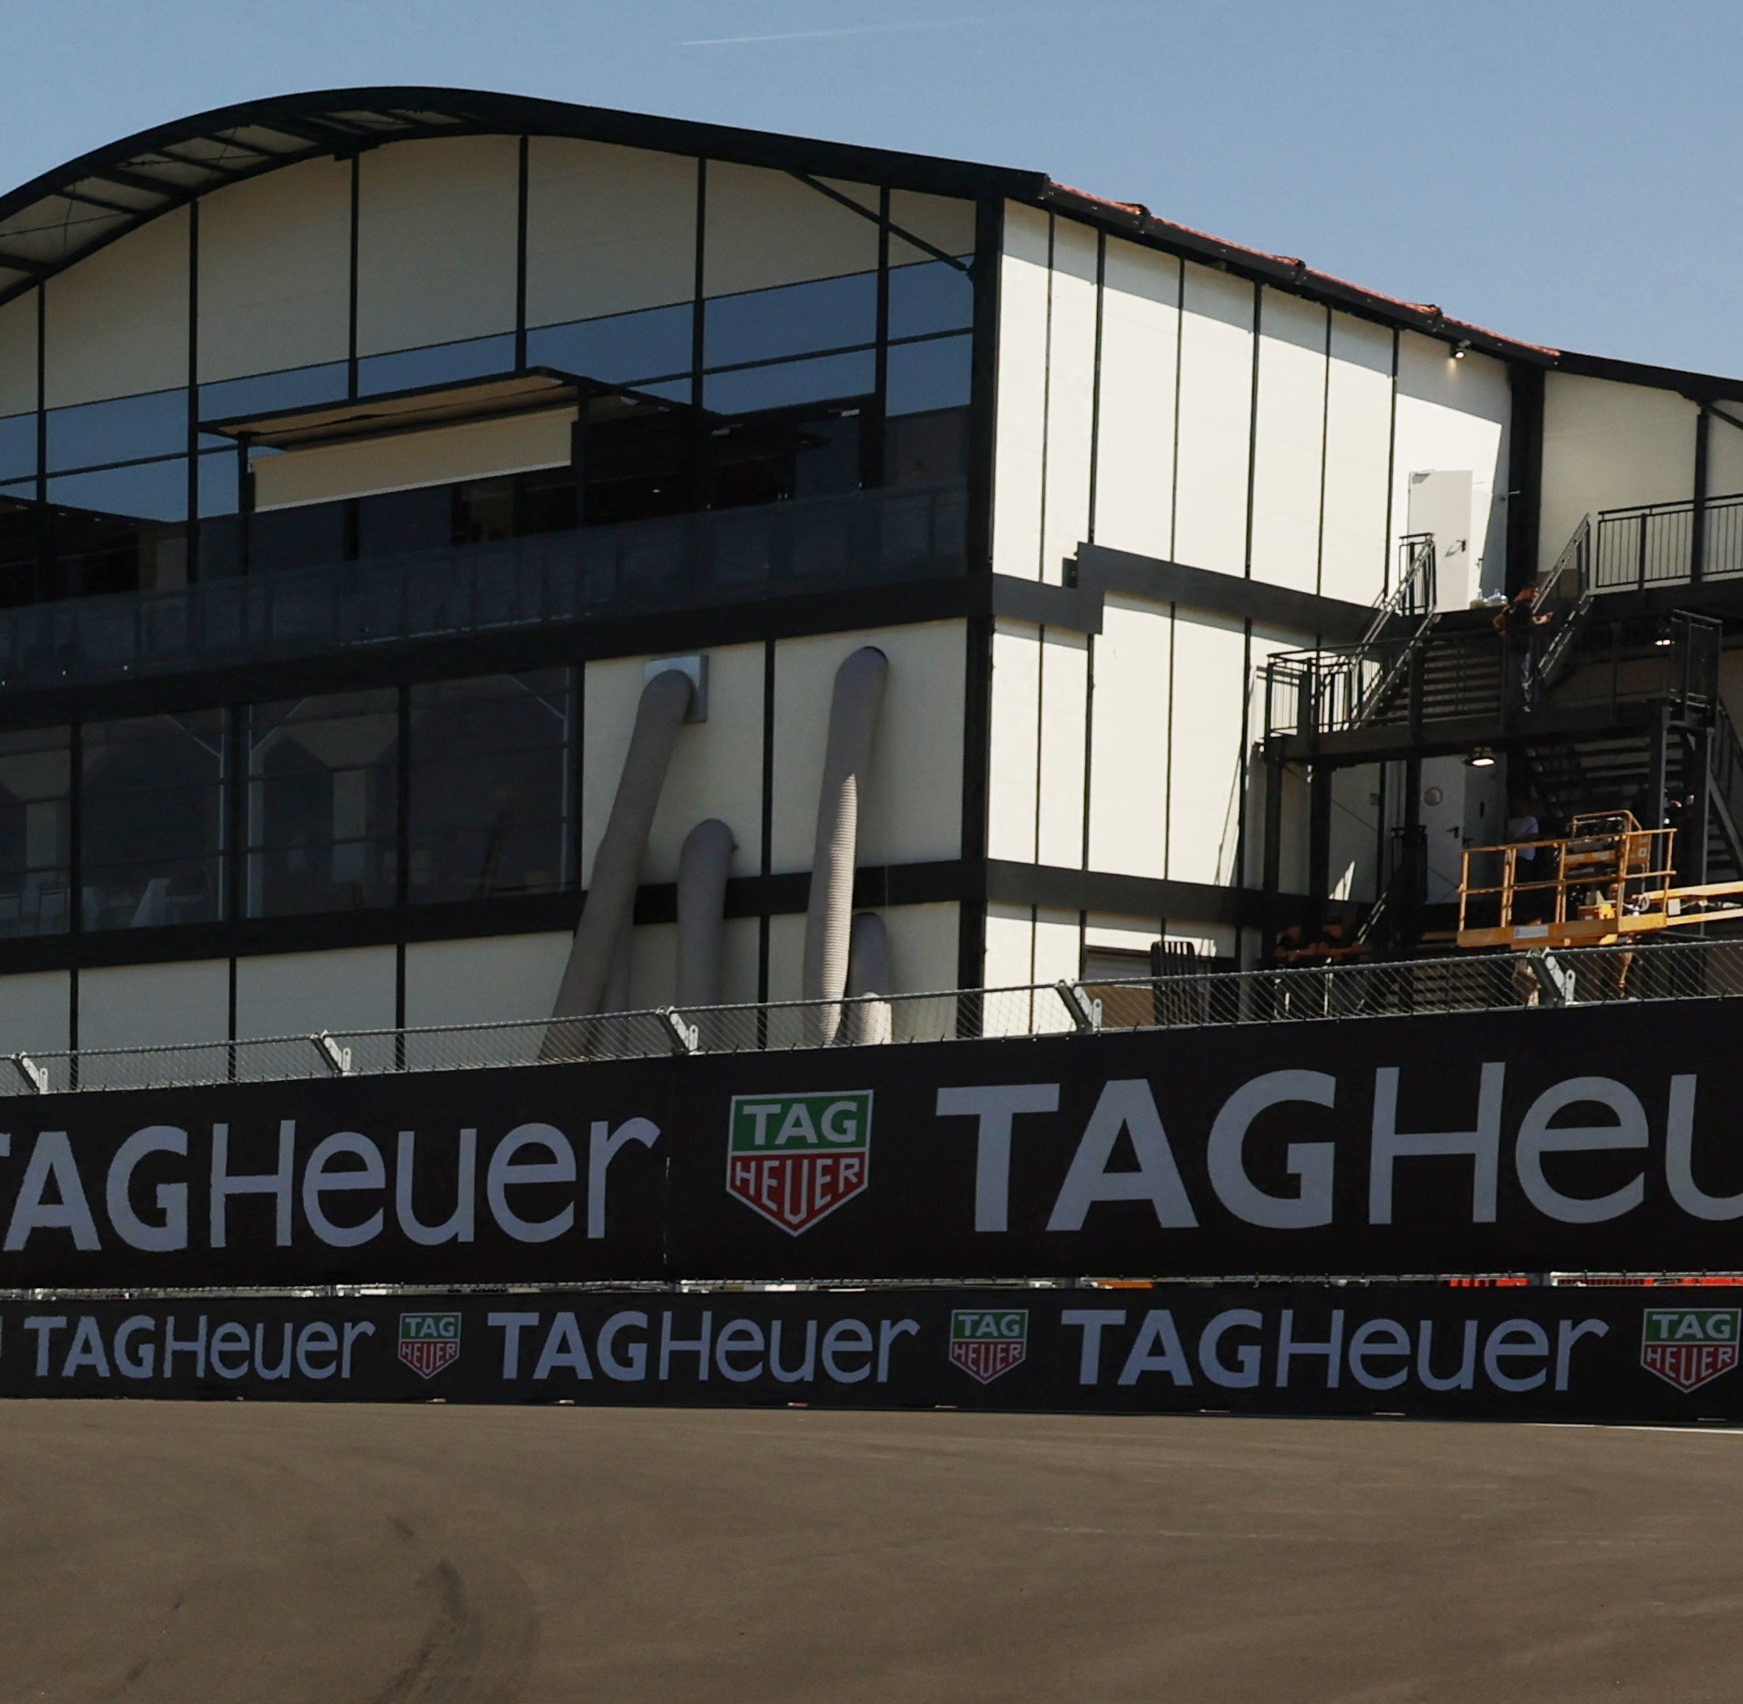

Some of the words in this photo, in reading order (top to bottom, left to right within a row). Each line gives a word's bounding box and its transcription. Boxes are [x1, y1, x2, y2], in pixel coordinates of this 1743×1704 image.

[742, 1100, 859, 1147] TAG
[734, 1157, 868, 1226] HEUER
[404, 1316, 458, 1339] TAG
[956, 1313, 1024, 1339] TAG
[1650, 1311, 1736, 1341] TAG
[24, 1315, 375, 1380] TAGHeuer
[400, 1341, 460, 1373] HEUER
[487, 1310, 920, 1384] TAGHeuer
[951, 1342, 1025, 1377] HEUER
[1061, 1308, 1609, 1392] TAGHeuer
[1644, 1346, 1740, 1387] HEUER
